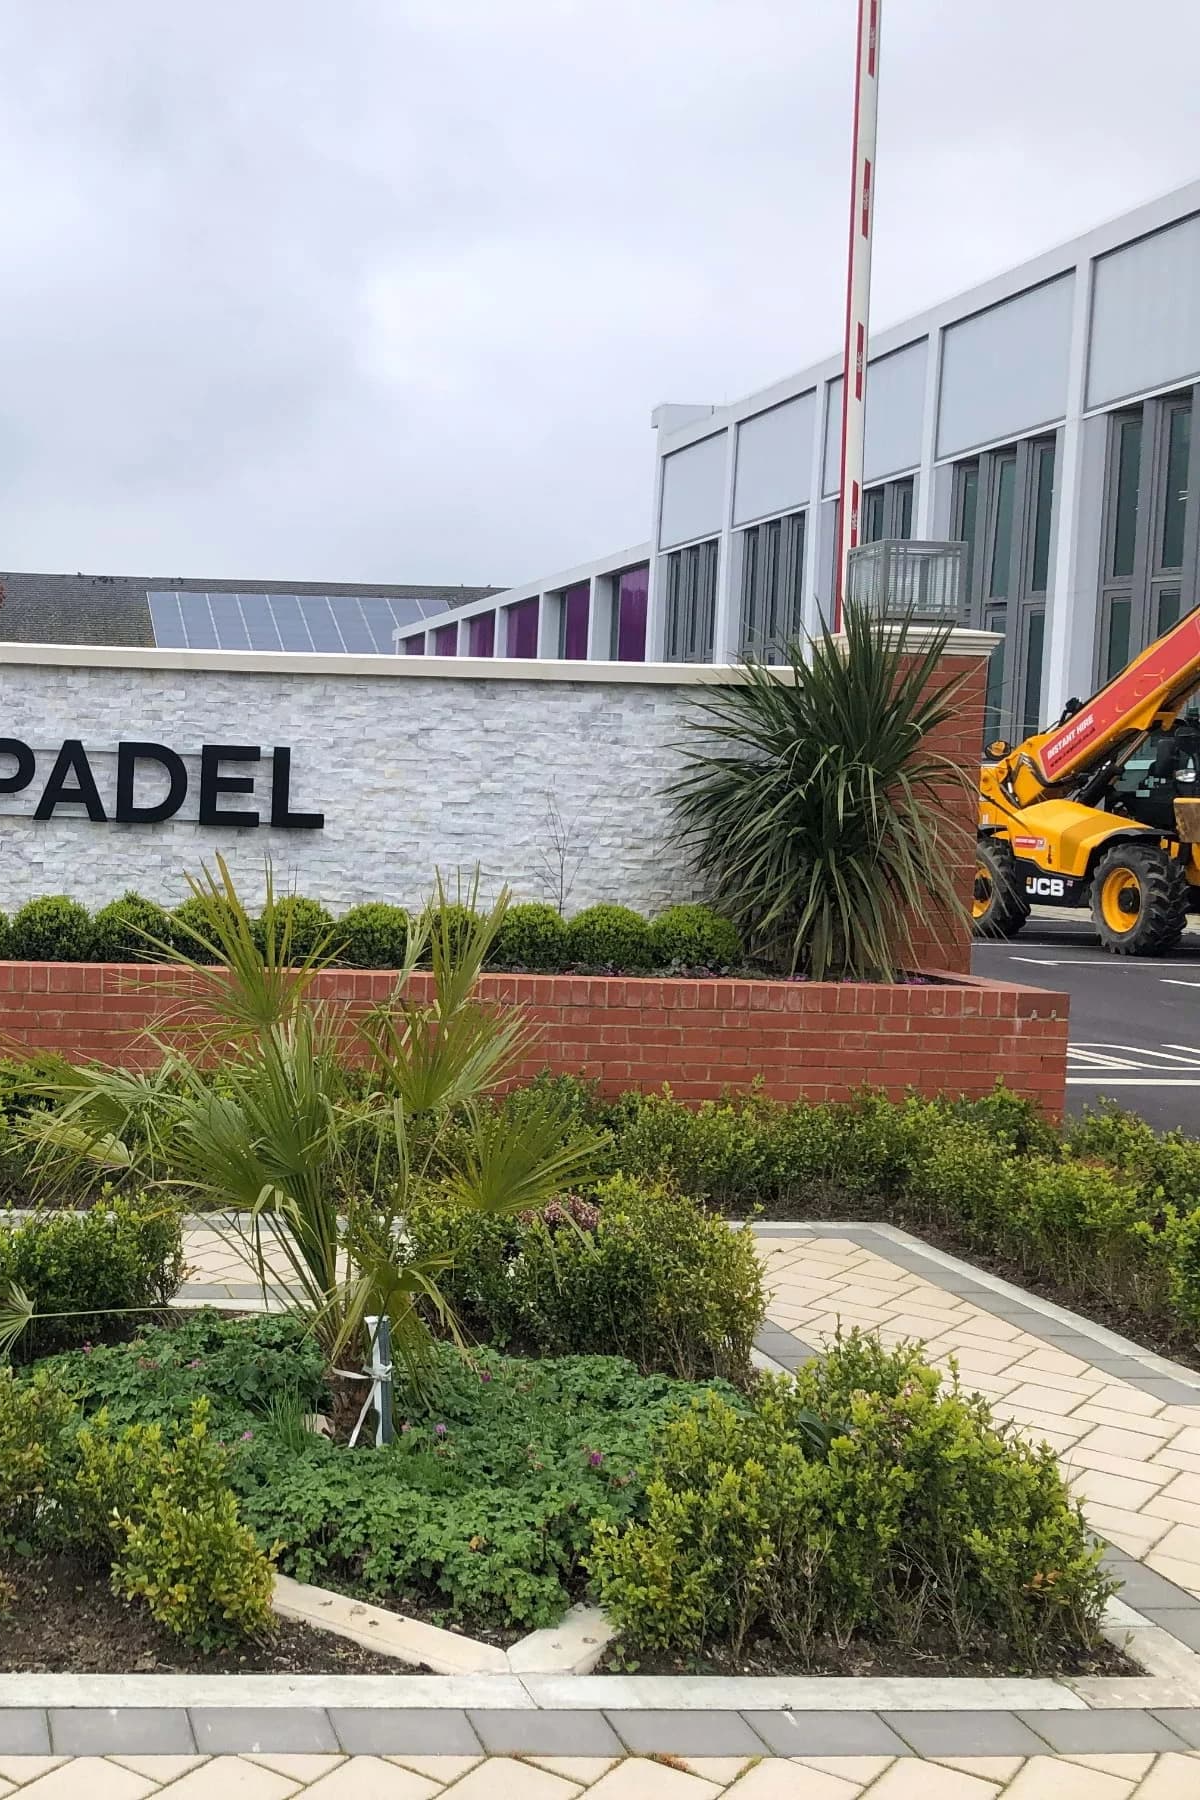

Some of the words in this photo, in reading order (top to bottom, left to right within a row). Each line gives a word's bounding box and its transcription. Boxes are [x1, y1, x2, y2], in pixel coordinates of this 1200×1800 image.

[1047, 728, 1076, 760] INSTANT
[1076, 713, 1094, 735] HIRE
[1025, 876, 1064, 897] JCB
